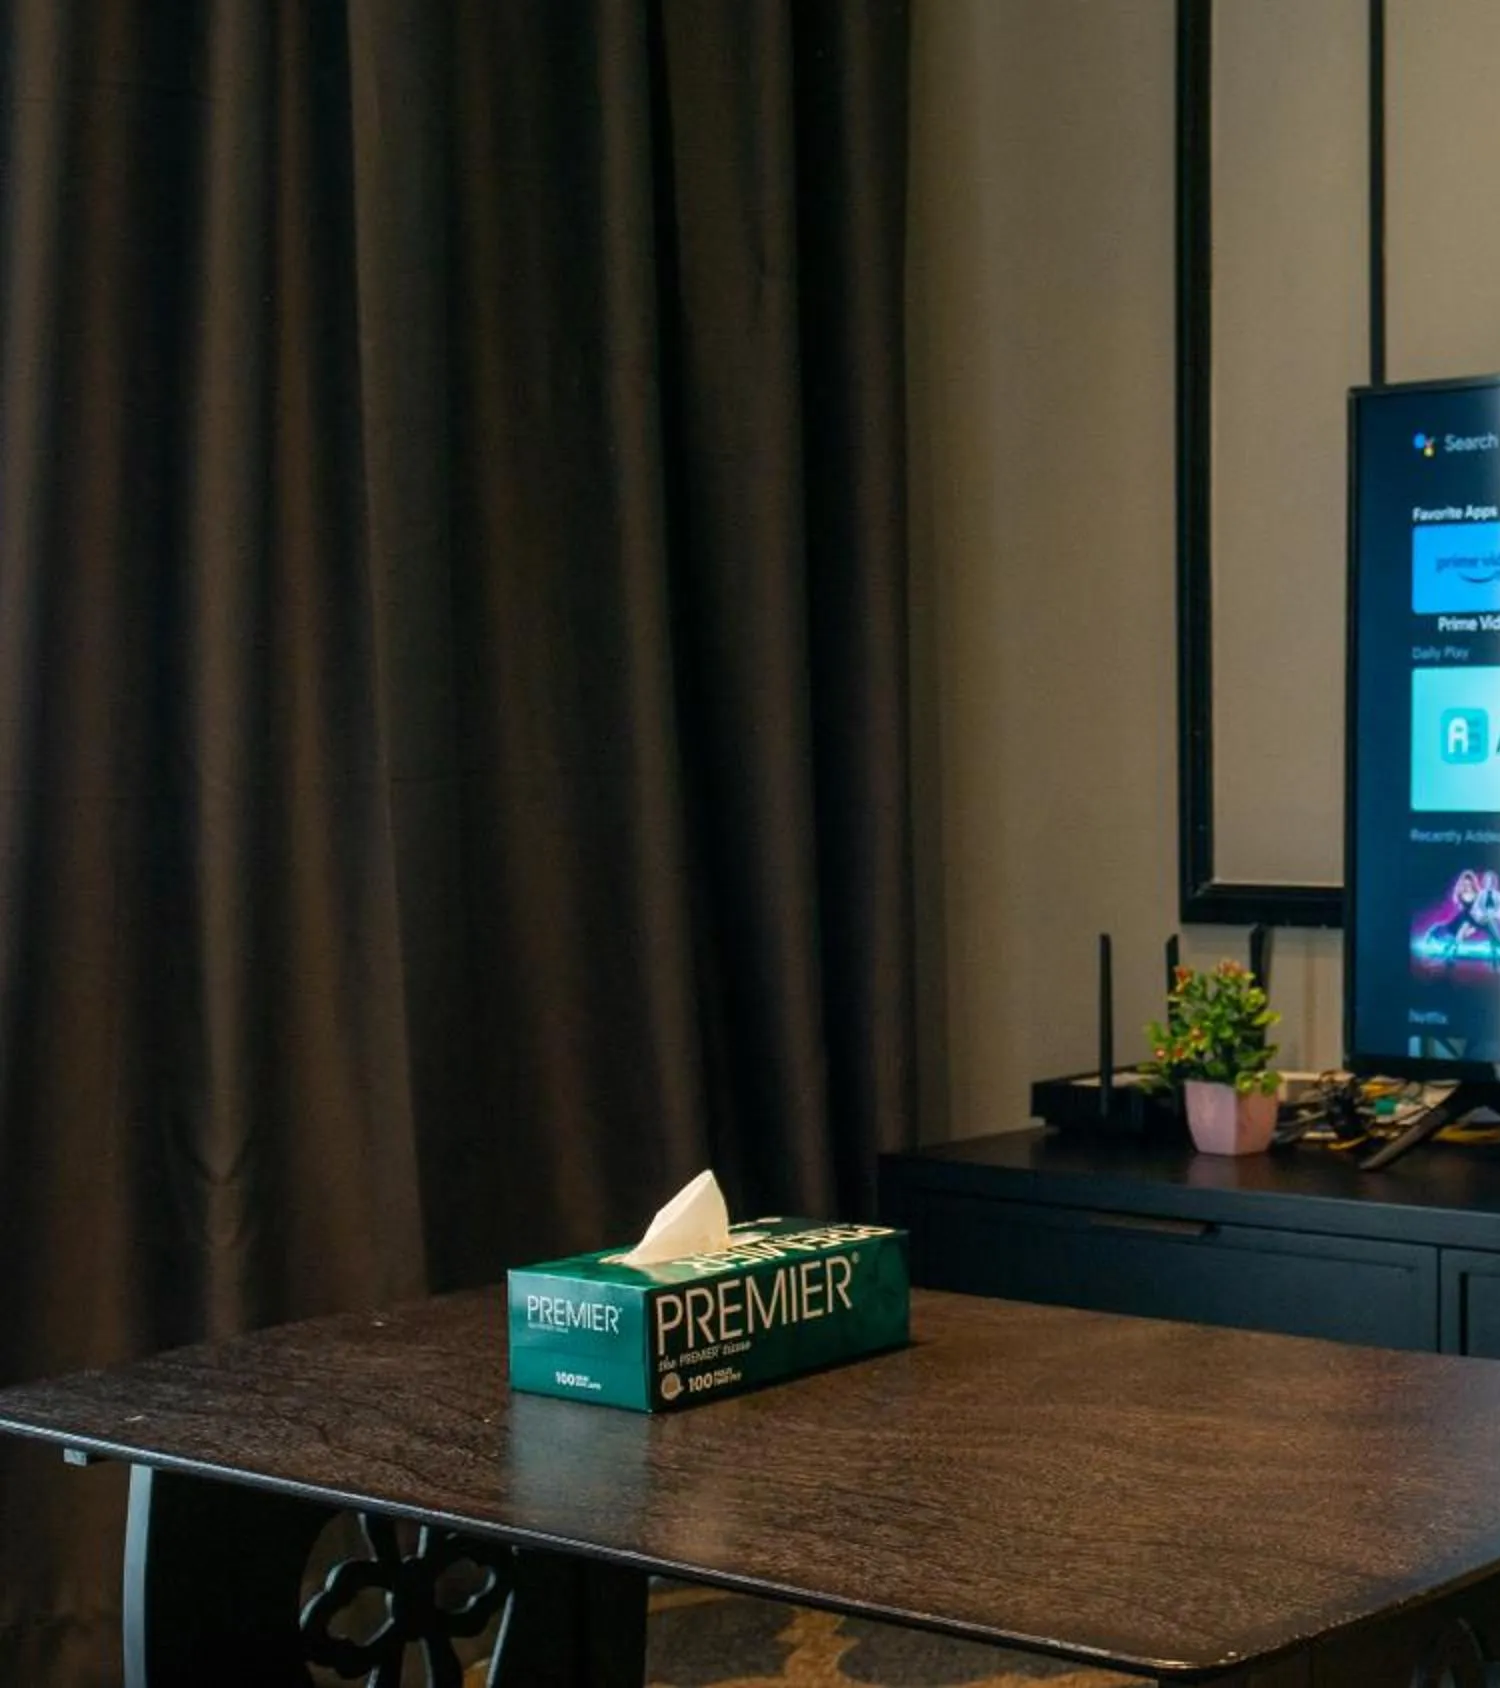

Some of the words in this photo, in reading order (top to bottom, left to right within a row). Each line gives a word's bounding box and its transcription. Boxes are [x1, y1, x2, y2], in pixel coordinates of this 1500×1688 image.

[1444, 433, 1499, 451] Search
[1412, 507, 1463, 521] Favorite
[1465, 504, 1498, 520] Apps
[1438, 616, 1478, 632] Prime
[1412, 647, 1441, 660] Daily
[656, 1256, 854, 1356] PREMIER
[527, 1295, 619, 1335] PREMIER
[555, 1371, 575, 1386] 100
[688, 1372, 713, 1392] 100
